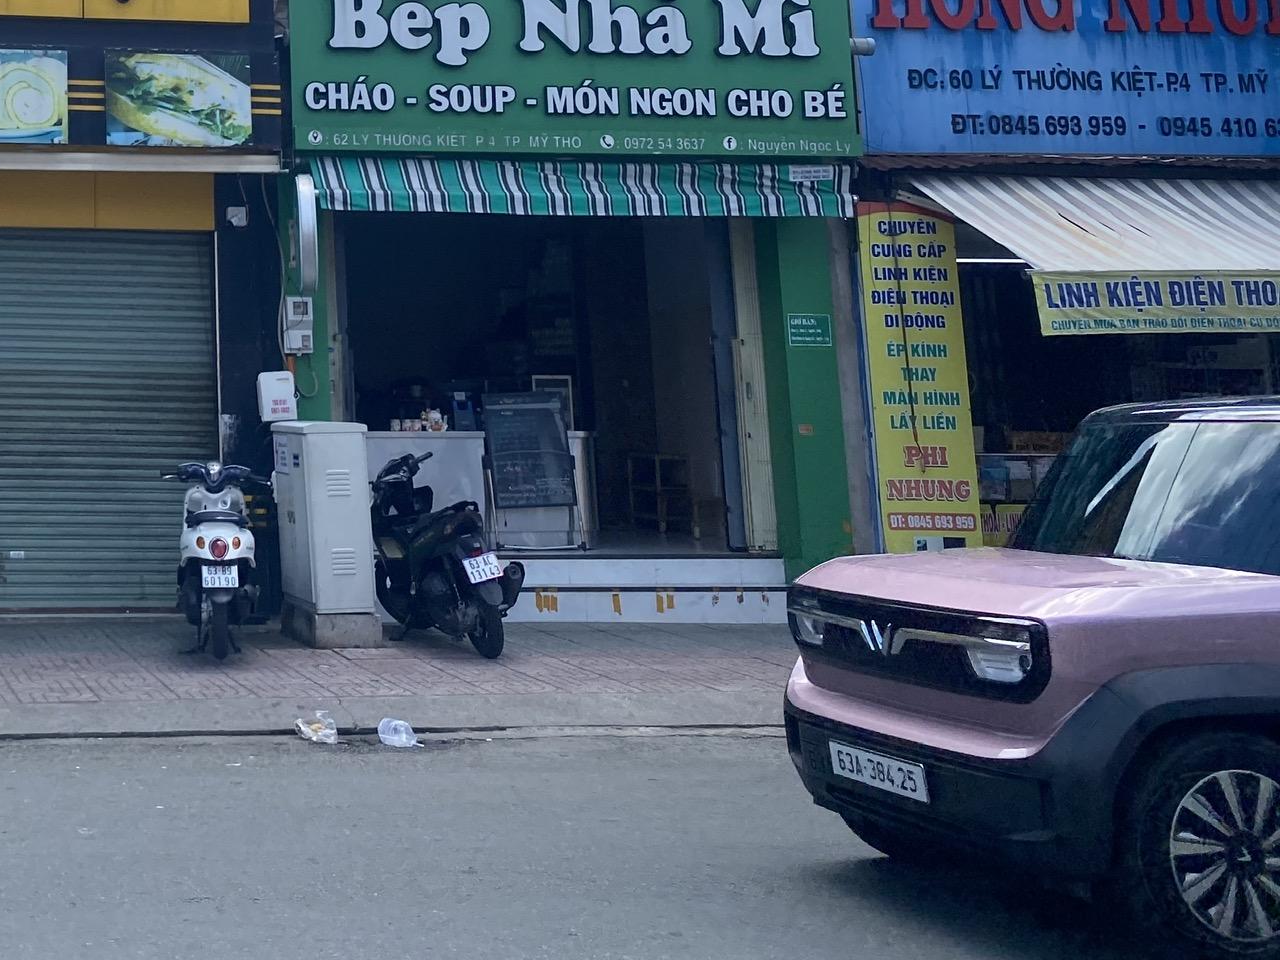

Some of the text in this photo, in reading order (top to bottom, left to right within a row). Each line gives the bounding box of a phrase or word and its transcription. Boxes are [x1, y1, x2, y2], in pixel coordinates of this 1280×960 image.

[948, 69, 973, 90] 60
[980, 64, 1003, 90] LÝ
[1012, 62, 1103, 91] THƯỜNG
[1238, 68, 1269, 94] MỸ
[305, 76, 847, 120] CHÁO SOUP MÓN NGON CHO BÉ
[333, 133, 349, 146] 62
[624, 137, 705, 150] 0972 54 3637
[877, 219, 937, 235] CHUYÊN
[871, 240, 947, 258] CUNG CẤP
[874, 265, 948, 284] LINH KIỆN
[871, 288, 955, 308] ĐIỆN THOẠI
[1045, 276, 1280, 312] LINH KIỆN ĐIỆN THO
[904, 311, 946, 331] ĐỘNG
[1093, 318, 1117, 329] MUA
[887, 341, 948, 358] ÉP KÍNH
[900, 367, 937, 382] THAY
[882, 388, 961, 406] MÀN HÌNH
[890, 410, 917, 430] LẤY
[904, 446, 949, 468] PHI
[886, 479, 971, 502] NHUNG
[908, 515, 932, 528] 0845
[935, 515, 953, 529] 693
[956, 515, 974, 529] 959
